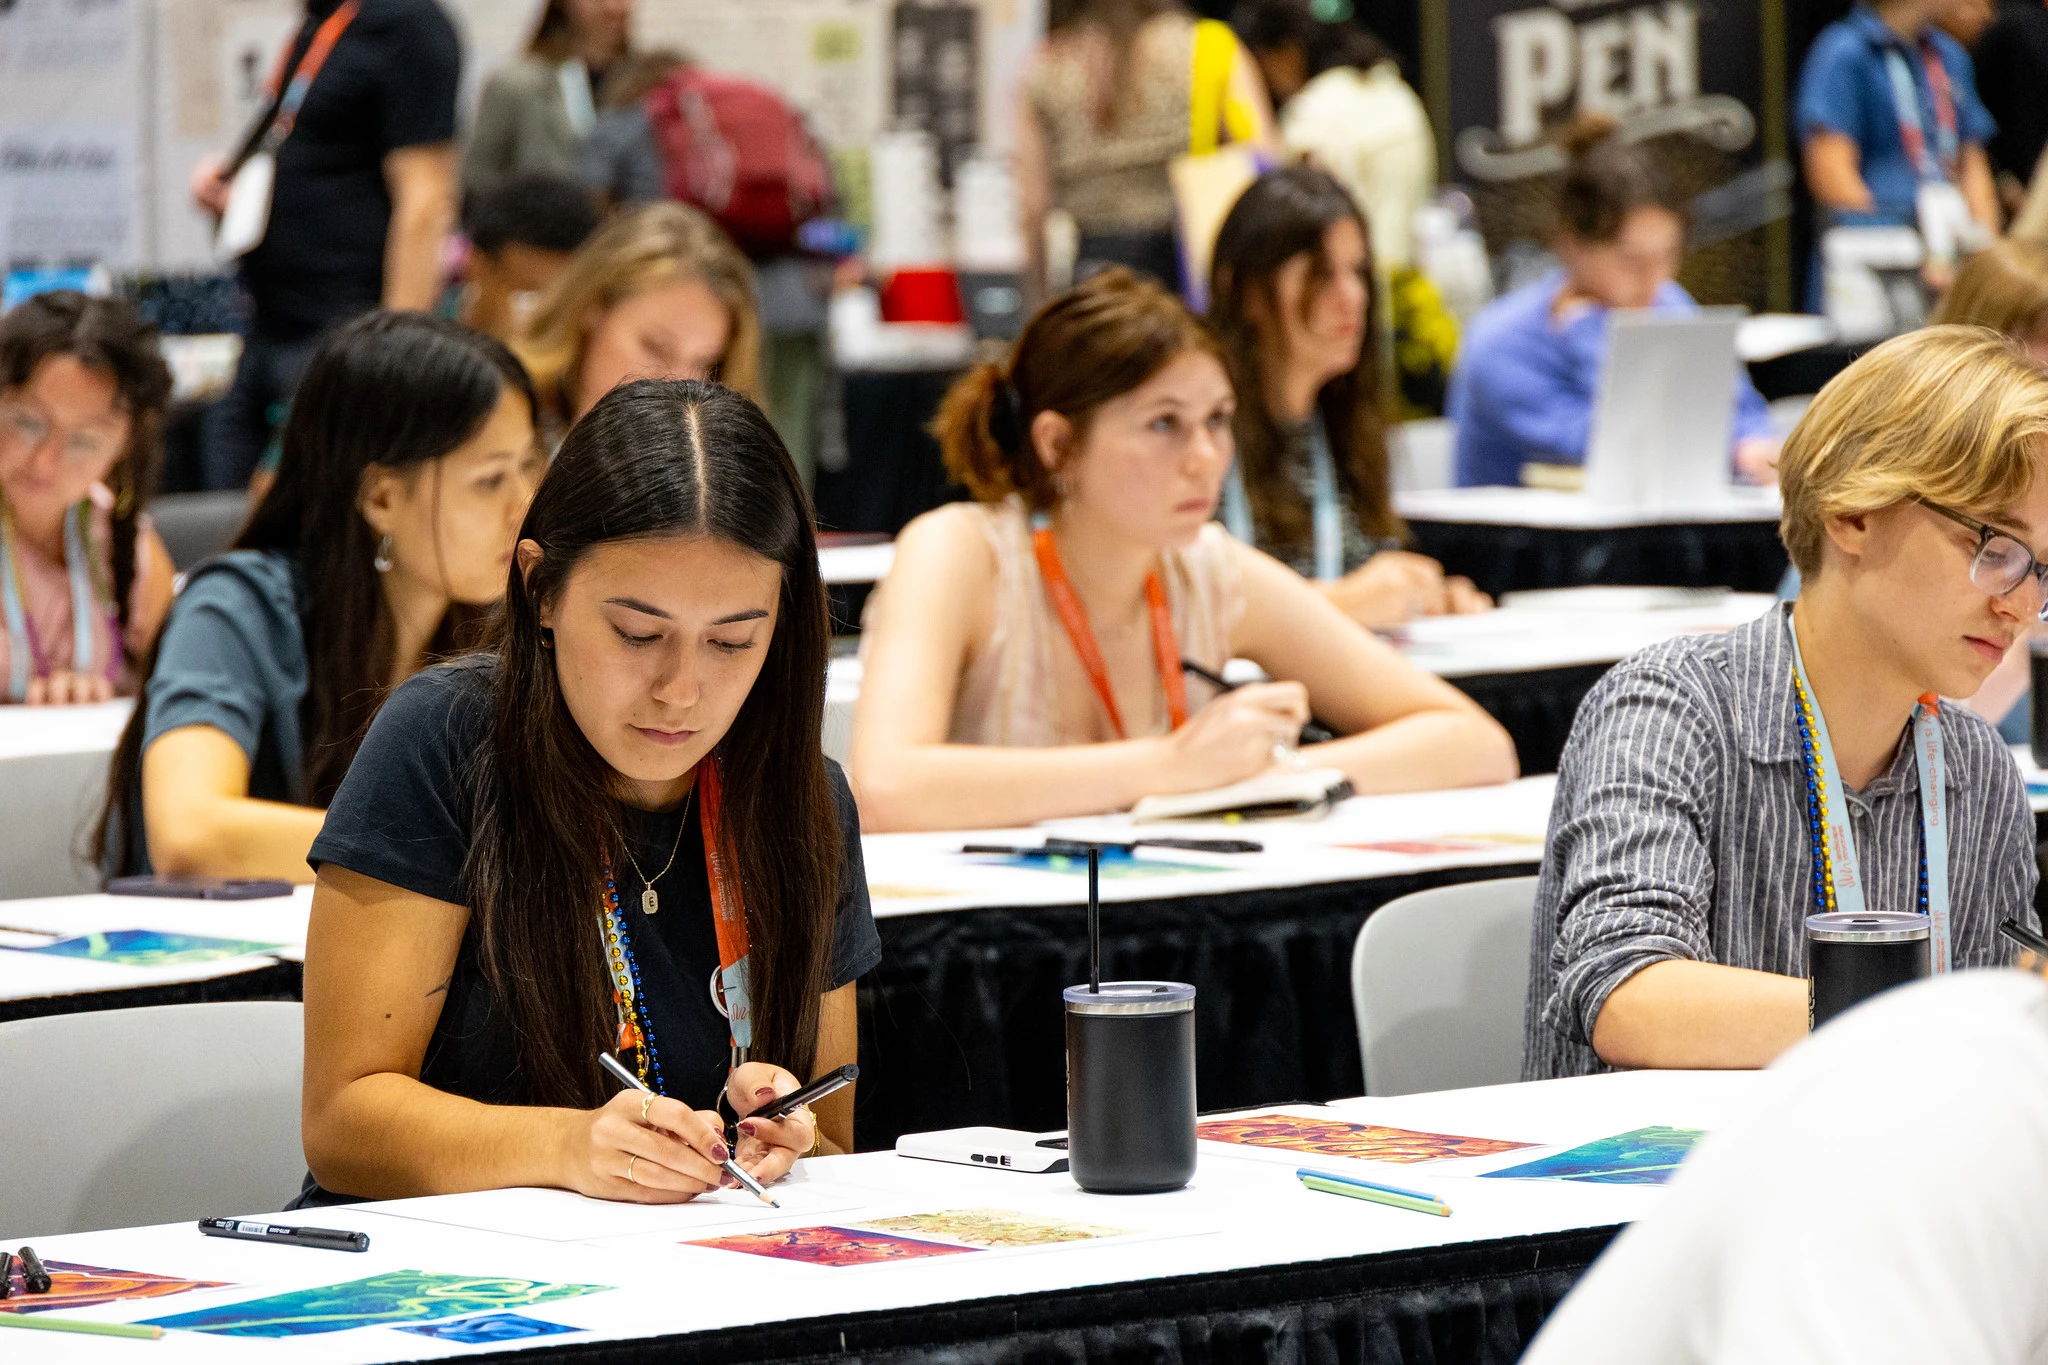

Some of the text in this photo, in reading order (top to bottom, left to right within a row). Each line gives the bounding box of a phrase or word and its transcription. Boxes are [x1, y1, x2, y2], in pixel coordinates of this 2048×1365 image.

[1492, 2, 1700, 146] PEN
[1924, 728, 1935, 737] is
[1926, 741, 1939, 827] life-changing
[647, 896, 655, 908] E
